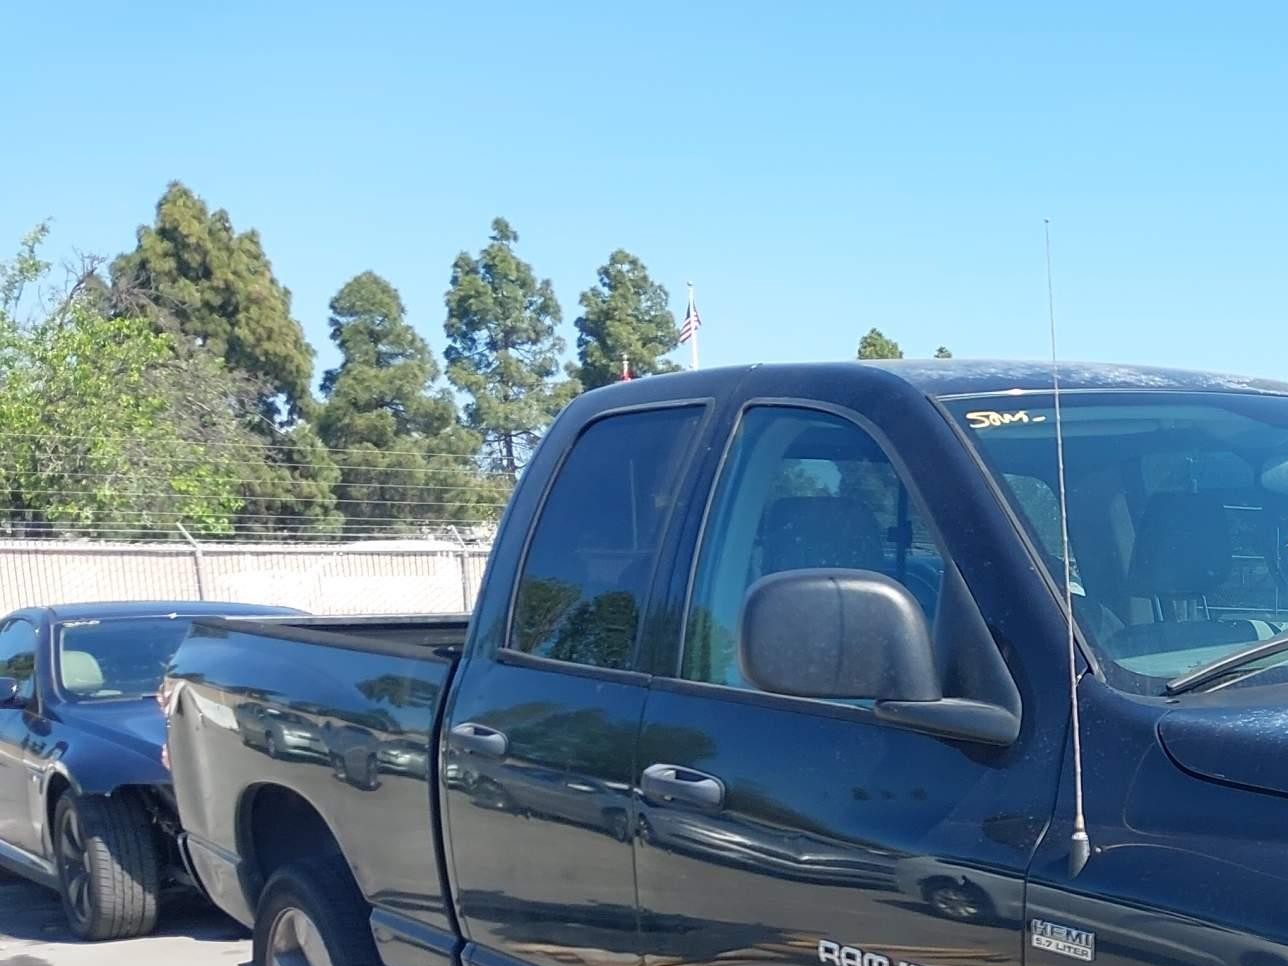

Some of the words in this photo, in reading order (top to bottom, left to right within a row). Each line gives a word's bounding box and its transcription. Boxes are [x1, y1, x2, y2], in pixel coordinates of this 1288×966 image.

[1031, 919, 1095, 948] HEMI
[1035, 937, 1053, 948] 5.7
[1056, 943, 1089, 958] LITER
